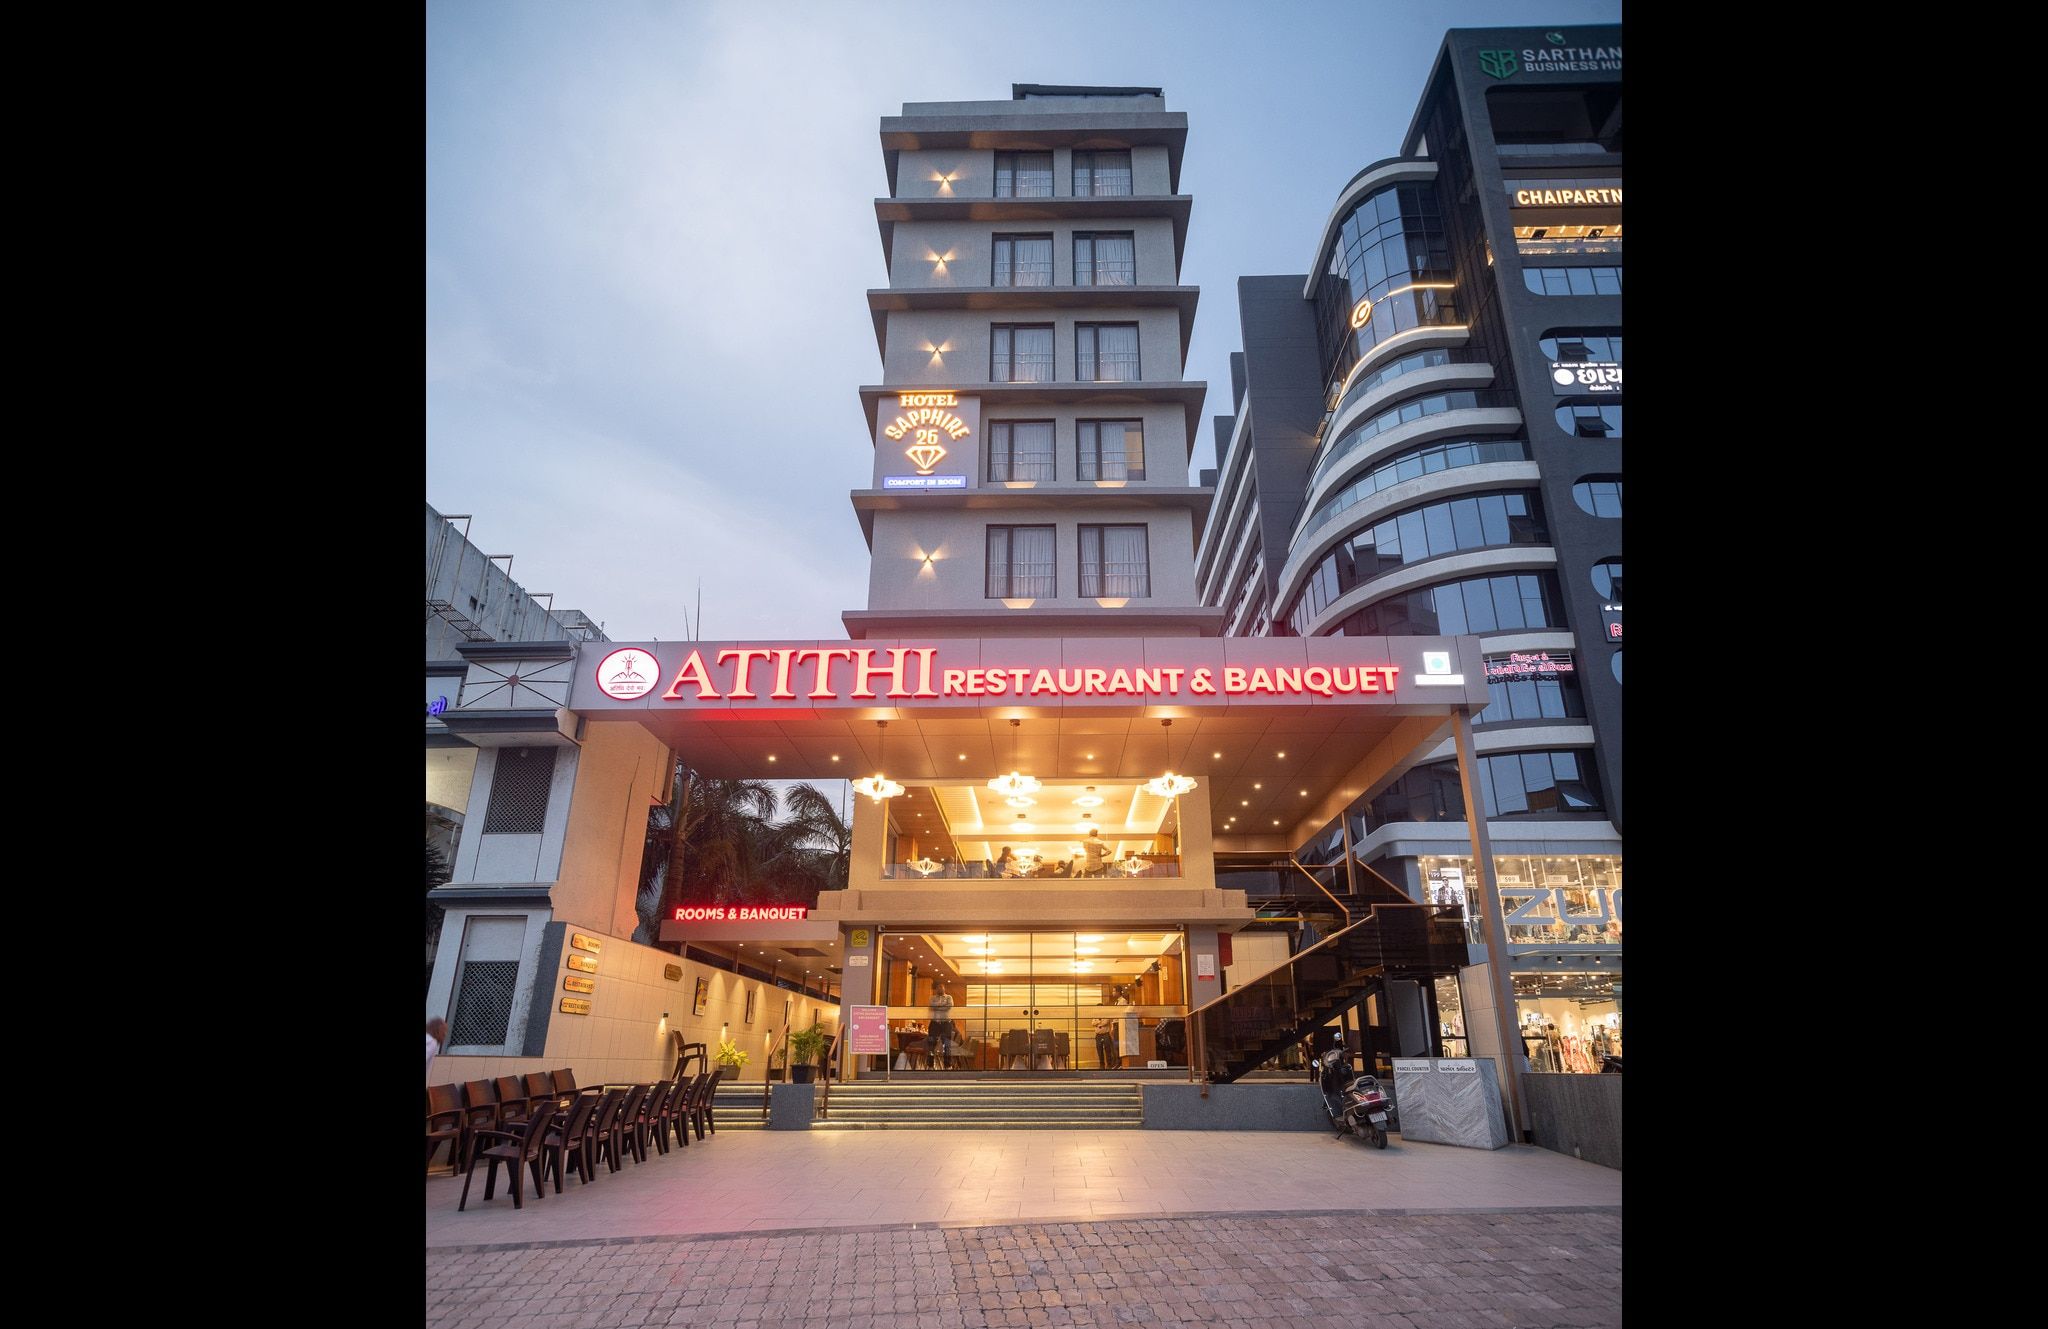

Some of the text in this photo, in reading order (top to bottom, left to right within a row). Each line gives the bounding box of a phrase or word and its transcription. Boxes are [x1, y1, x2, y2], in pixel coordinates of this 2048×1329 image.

[1525, 60, 1599, 72] BUSINESS
[900, 394, 958, 407] HOTEL
[885, 408, 970, 440] SAPPHIRE
[916, 429, 939, 445] 26
[661, 647, 939, 700] ATITHI
[943, 665, 1400, 697] RESTAURANT & BANQUET
[676, 907, 806, 921] ROOMS & BANQUET
